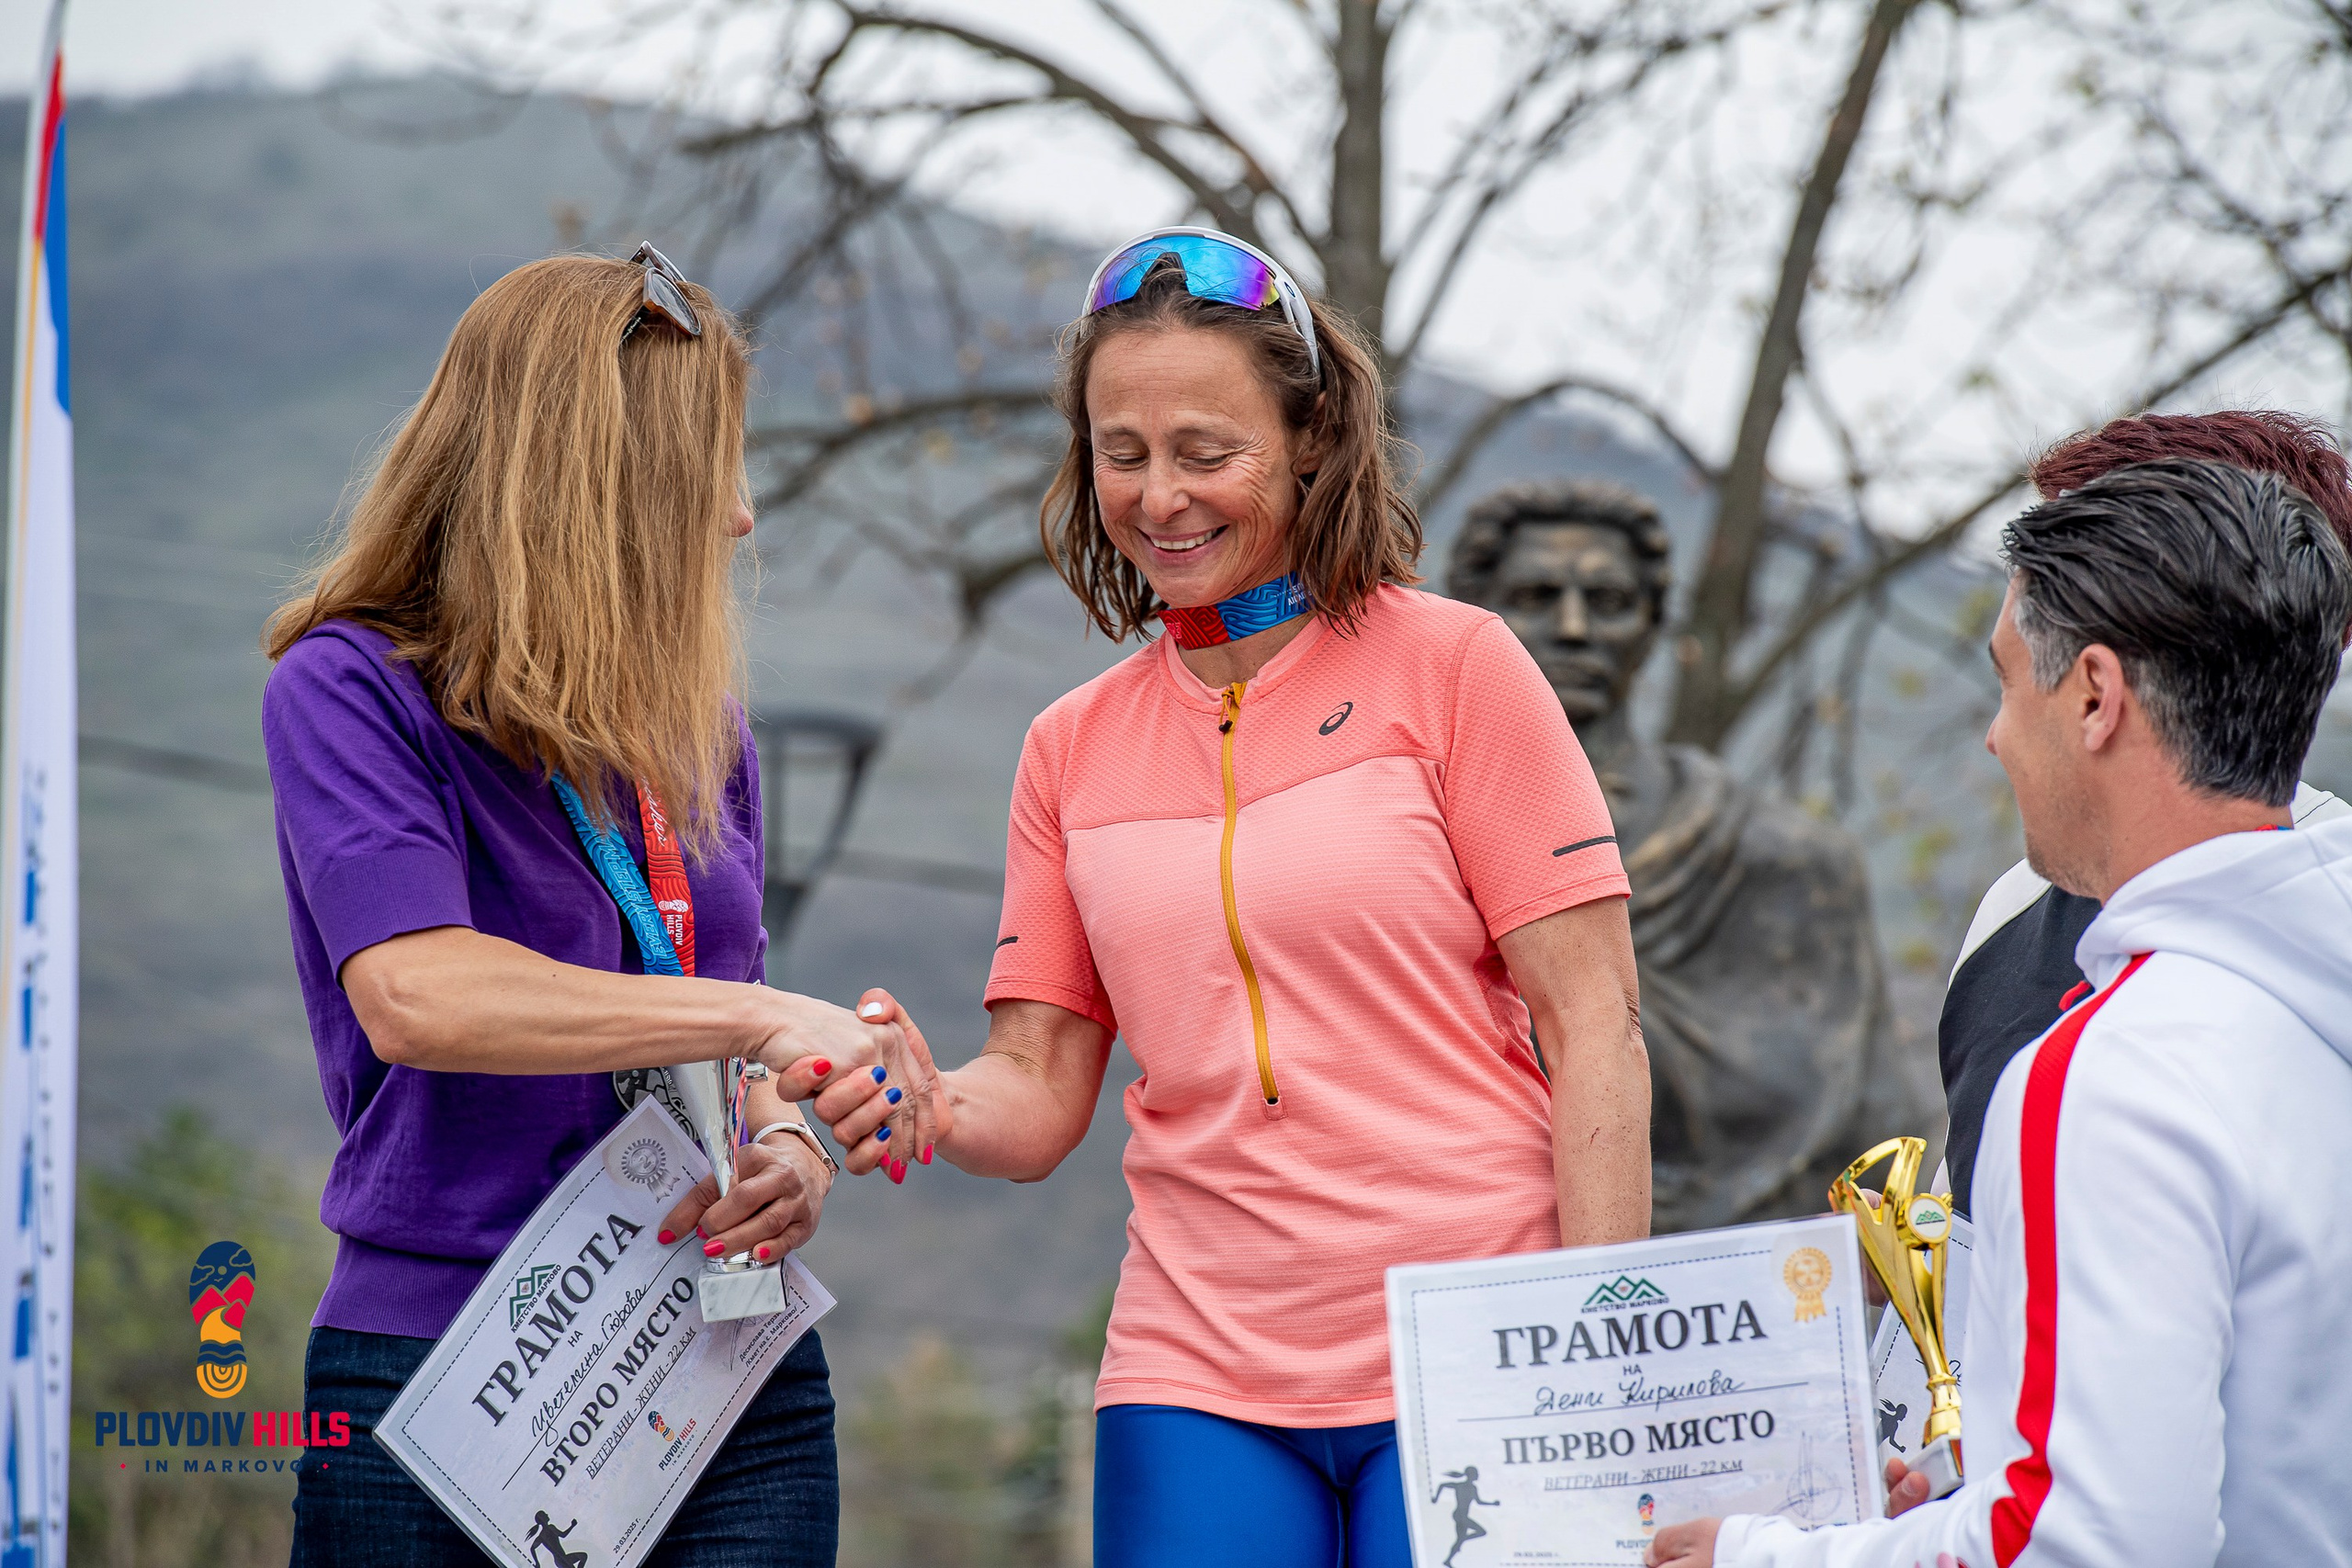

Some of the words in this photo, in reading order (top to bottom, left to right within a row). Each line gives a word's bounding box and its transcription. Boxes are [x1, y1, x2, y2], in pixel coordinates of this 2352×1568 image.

[611, 865, 642, 903] STEP
[631, 903, 667, 957] EVERY
[666, 914, 674, 935] HILLS
[675, 914, 684, 947] PLOVDIV
[471, 1213, 645, 1427] ГРАМОТА
[511, 1297, 538, 1333] КМЕТСТВО
[537, 1264, 561, 1297] МАРКОВО
[568, 1330, 583, 1348] НА
[739, 1328, 765, 1362] Десислава
[1493, 1300, 1769, 1369] ГРАМОТА
[539, 1382, 619, 1487] ВТОРО
[612, 1277, 695, 1386] МЯСТО
[1623, 1363, 1643, 1376] НА
[585, 1413, 635, 1480] ВЕТЕРАНИ
[636, 1366, 666, 1408] ЖЕНИ
[667, 1345, 682, 1364] 22
[659, 1438, 683, 1471] PLOVDIV
[679, 1417, 696, 1441] HILLS
[1501, 1427, 1635, 1465] ПЪРВО
[1645, 1409, 1775, 1453] МЯСТО
[1544, 1471, 1629, 1491] ВЕТЕРАНИ
[1640, 1463, 1690, 1483] ЖЕНИ
[1700, 1460, 1717, 1475] 22
[613, 1521, 637, 1554] 29.03.2025
